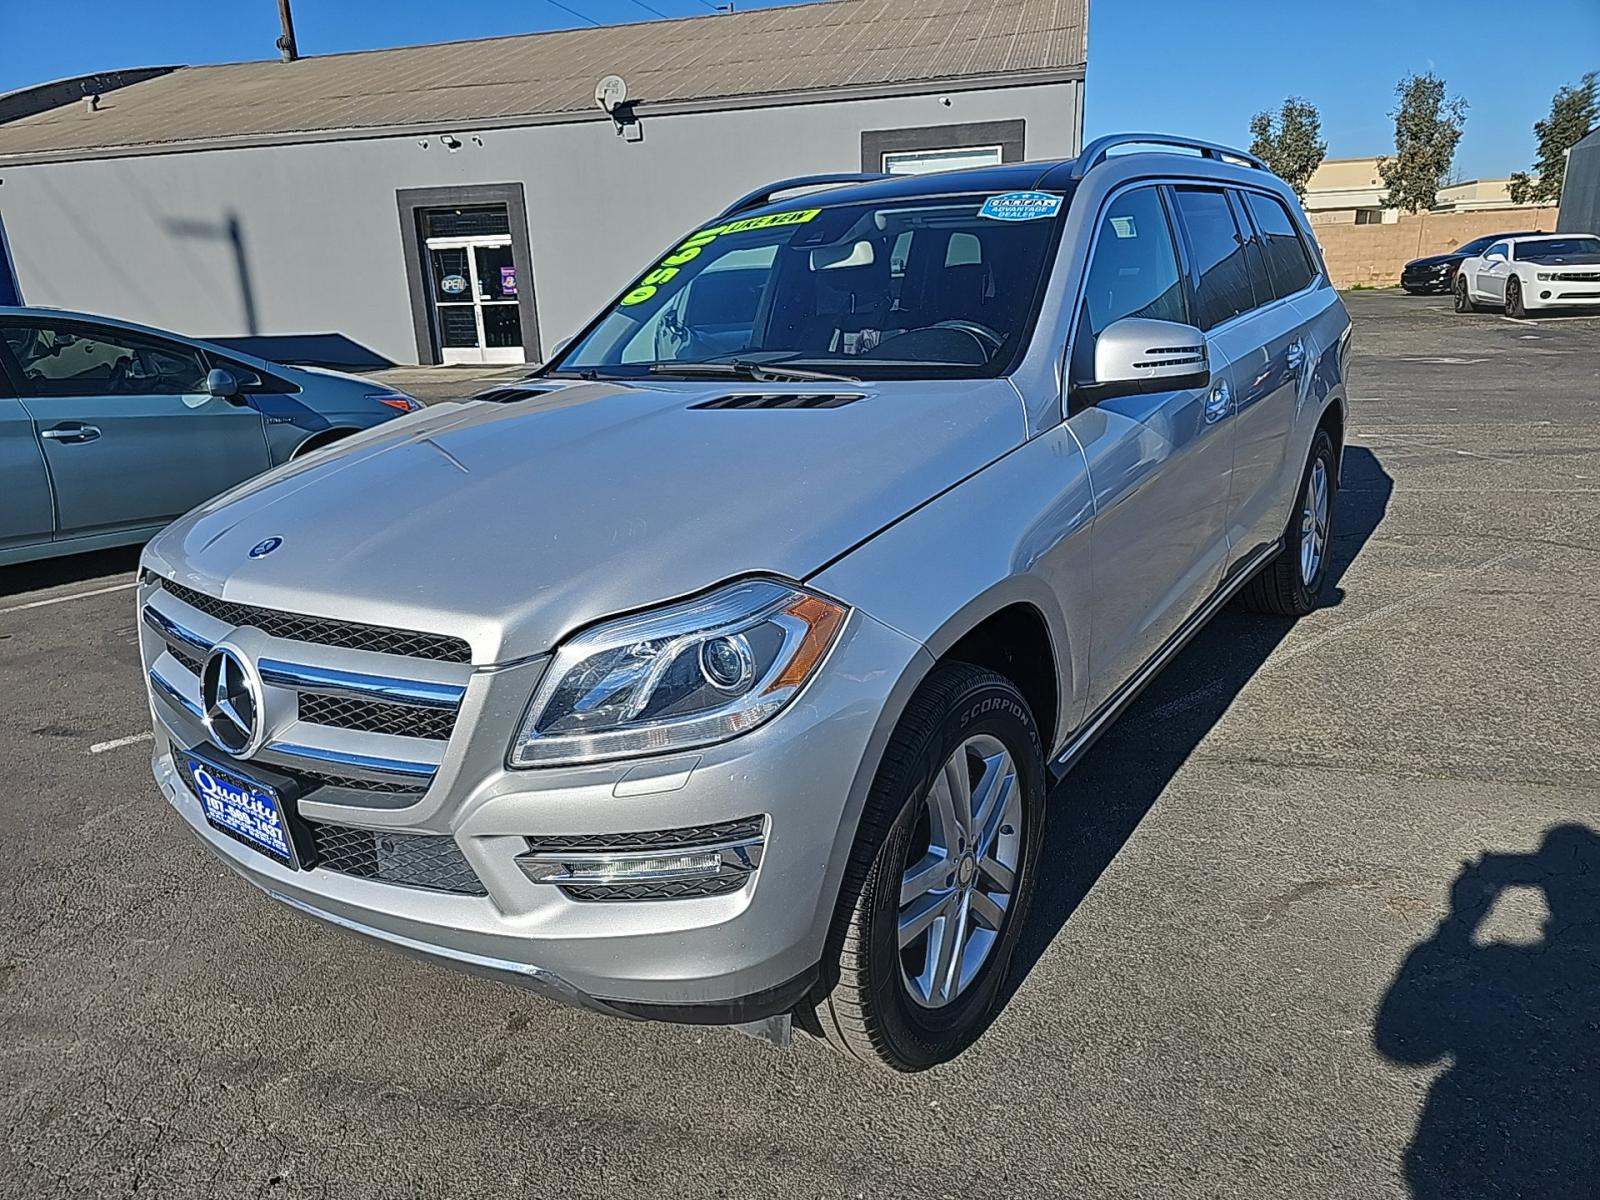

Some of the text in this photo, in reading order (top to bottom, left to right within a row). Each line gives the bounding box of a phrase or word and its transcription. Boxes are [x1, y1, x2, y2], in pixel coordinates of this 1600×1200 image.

[727, 210, 815, 232] LIKE NEW
[441, 278, 466, 290] OPEN
[960, 697, 1029, 728] SCORPION
[193, 764, 280, 825] Quality
